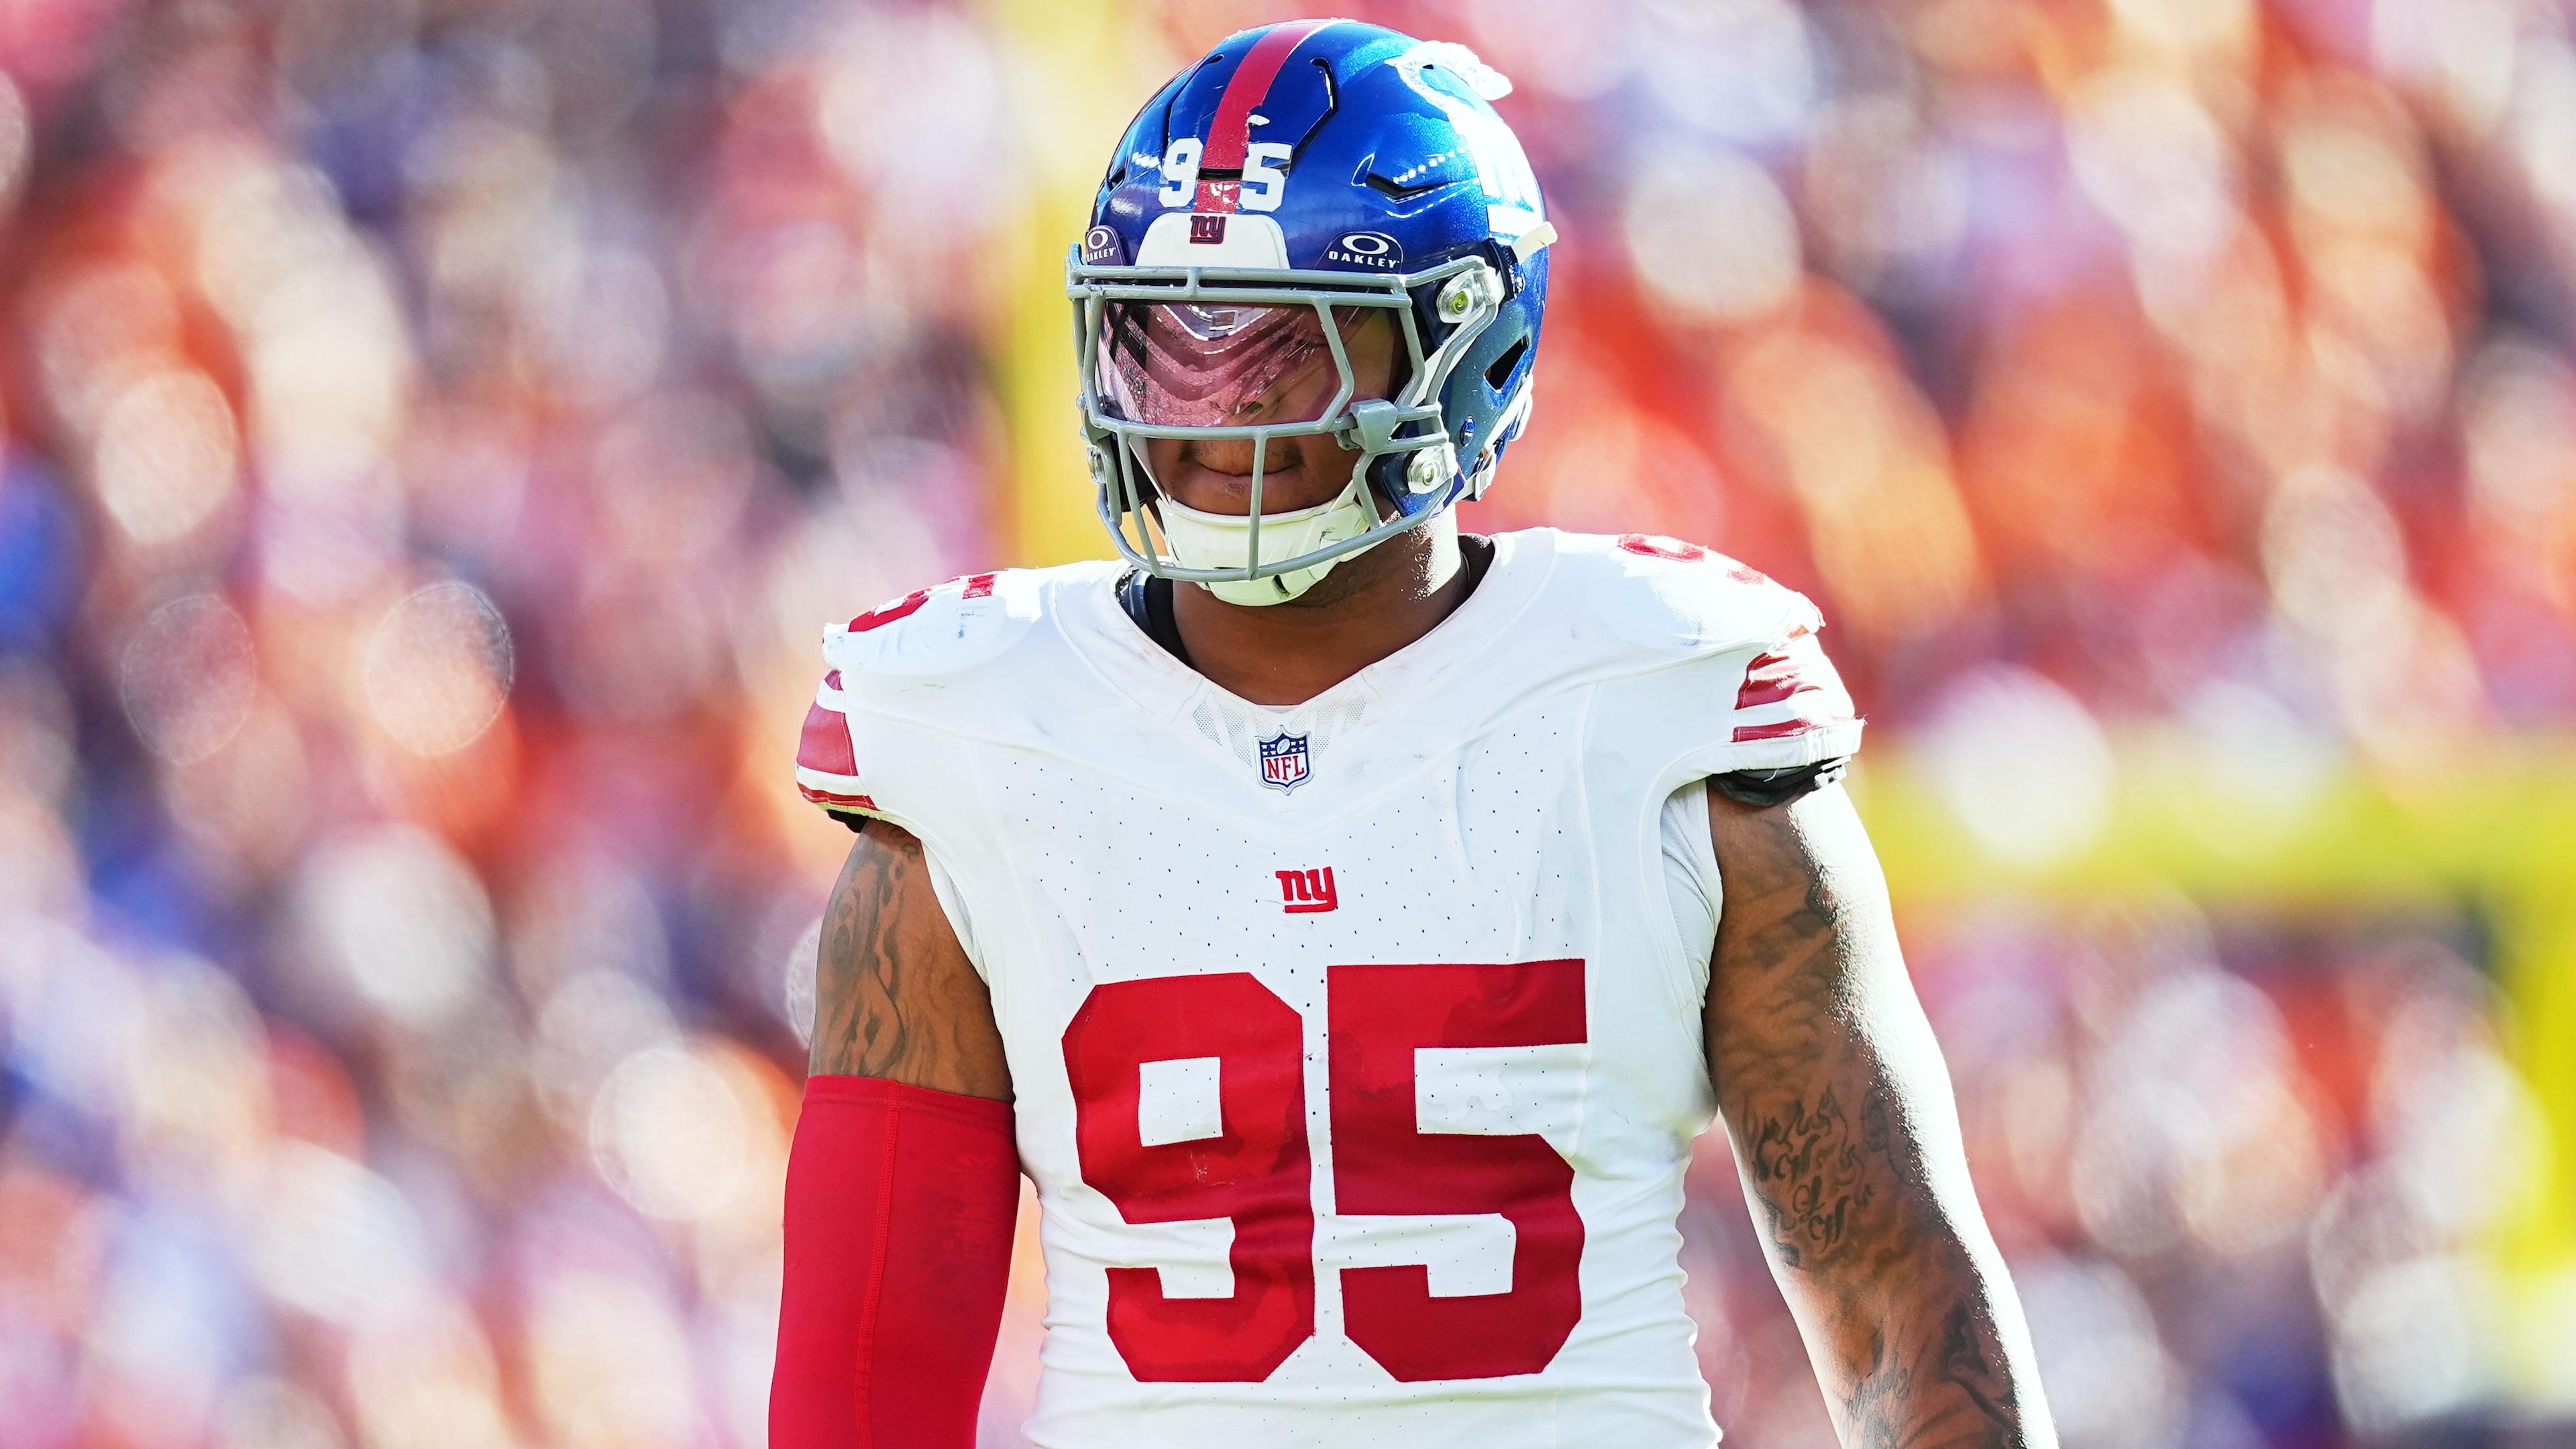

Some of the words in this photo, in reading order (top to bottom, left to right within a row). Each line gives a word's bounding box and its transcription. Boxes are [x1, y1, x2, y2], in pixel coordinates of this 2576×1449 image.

[1328, 250, 1397, 268] OAKLEY
[1265, 755, 1305, 781] NFL
[1061, 958, 1588, 1383] 95
